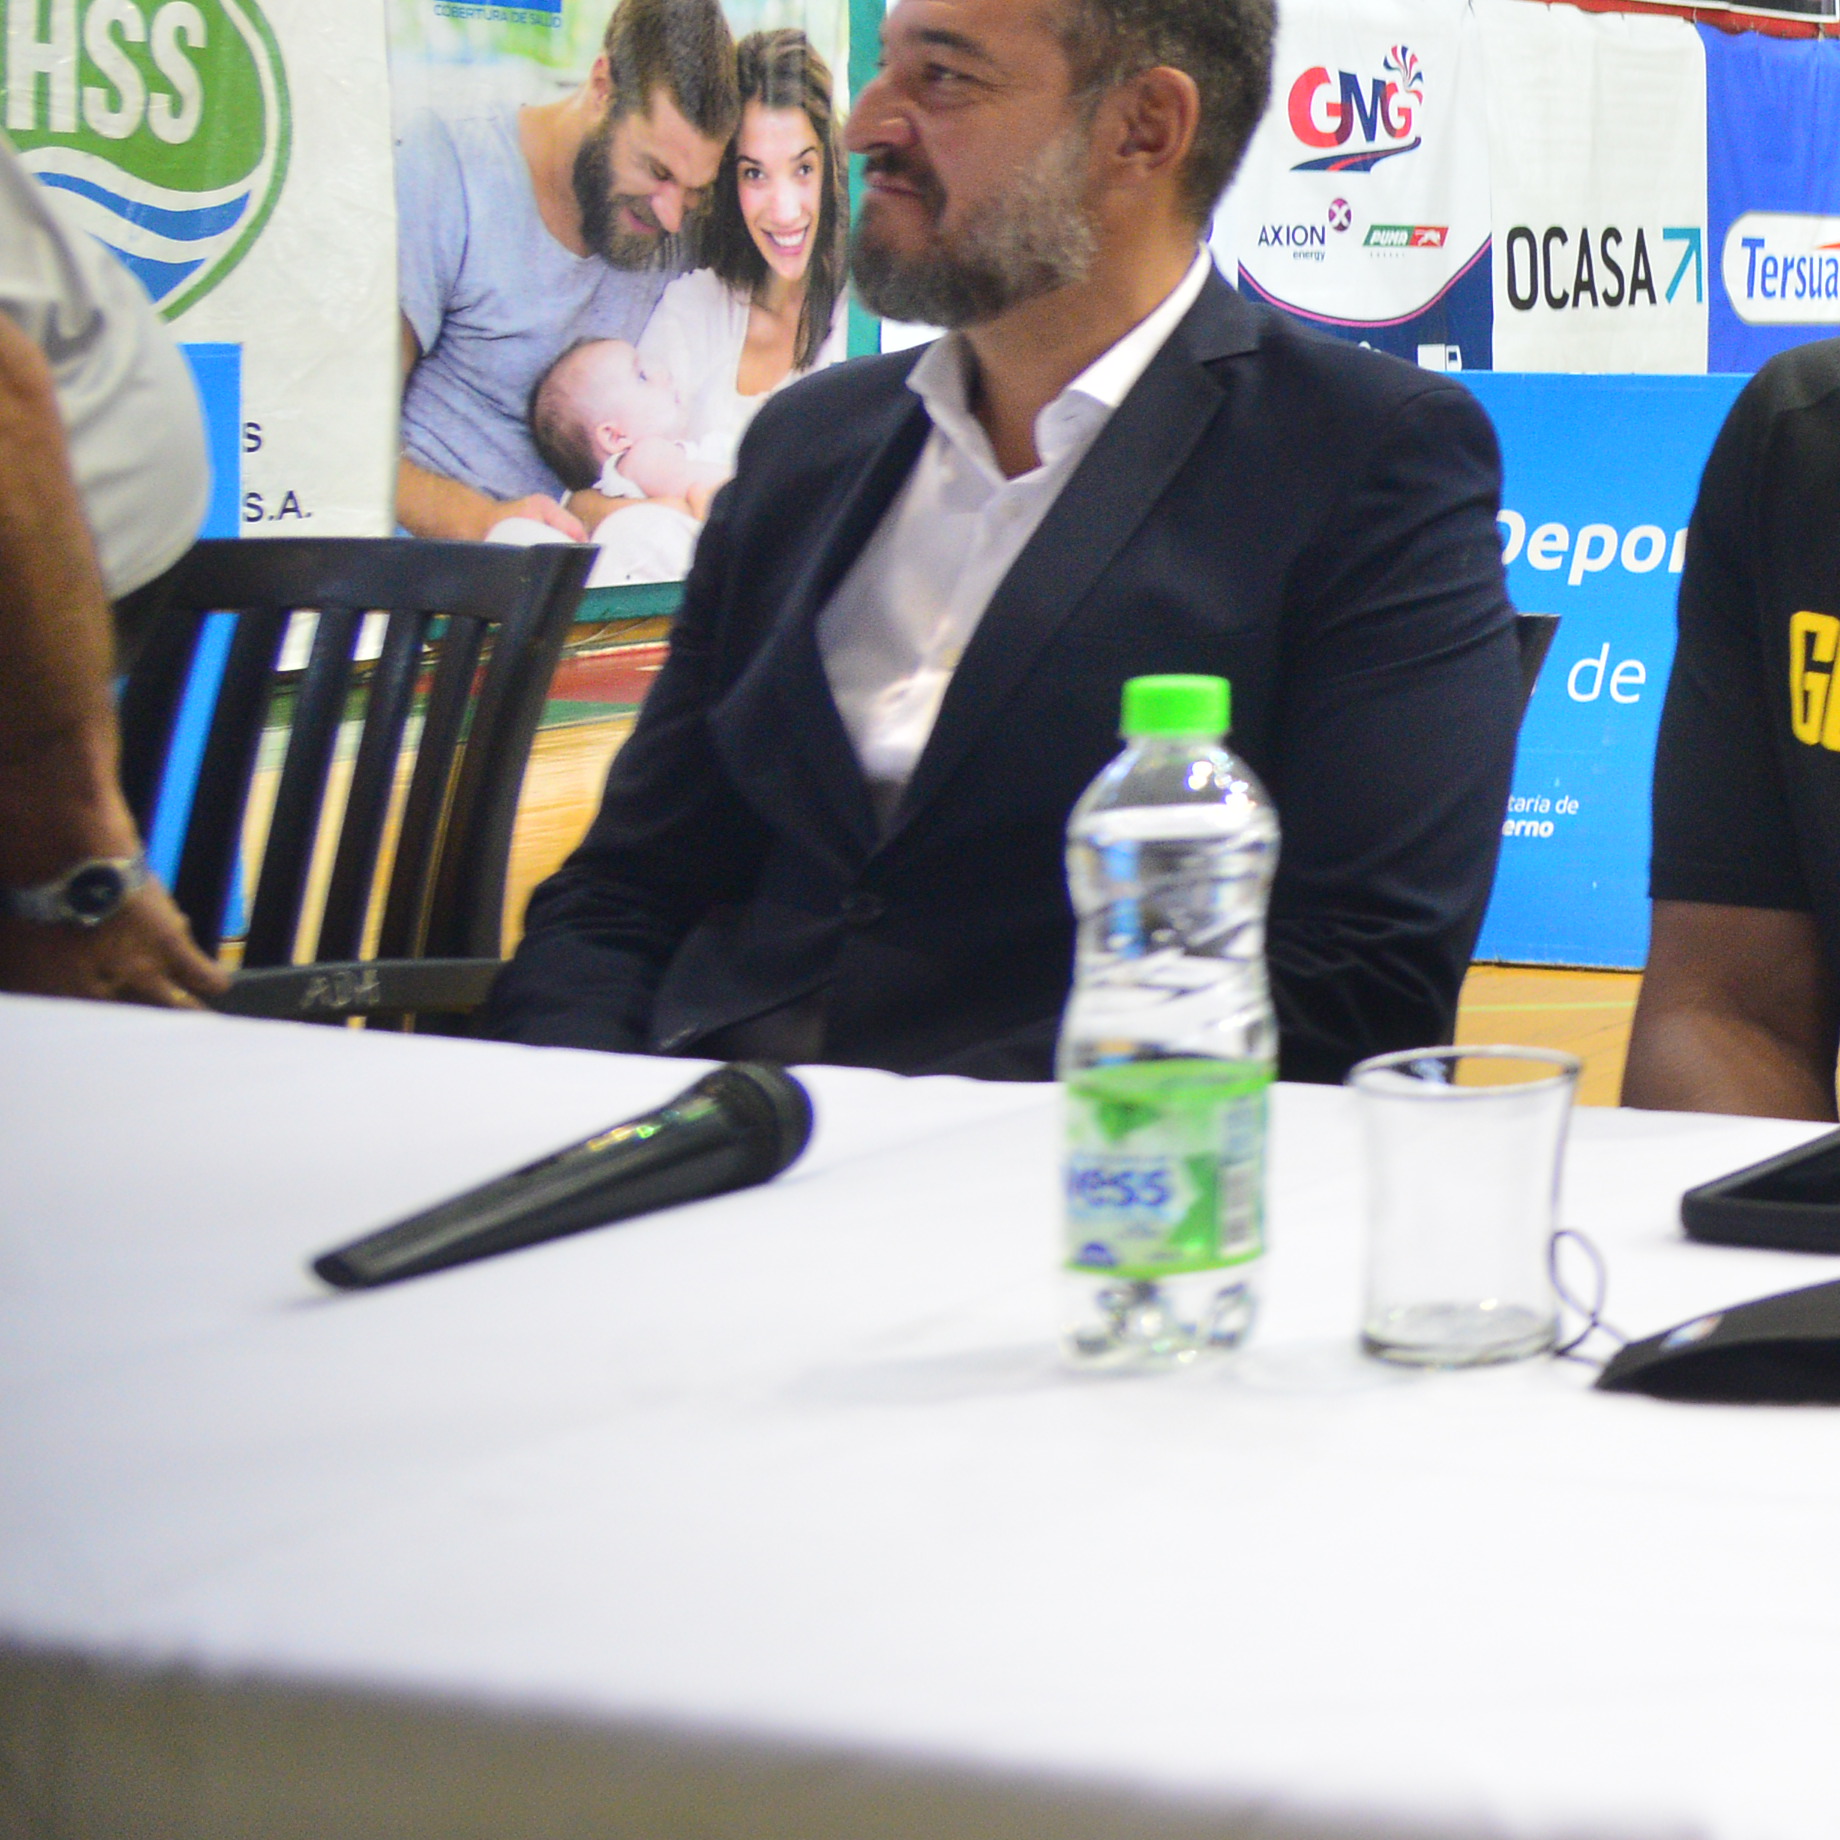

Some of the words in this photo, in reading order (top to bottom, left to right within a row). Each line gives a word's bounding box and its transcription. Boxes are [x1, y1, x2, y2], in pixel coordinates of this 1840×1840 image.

[1288, 65, 1415, 148] GMG
[1258, 224, 1326, 248] AXION
[1293, 250, 1327, 261] energy
[1506, 226, 1658, 311] OCASA
[1567, 642, 1647, 704] de
[1555, 794, 1580, 815] de
